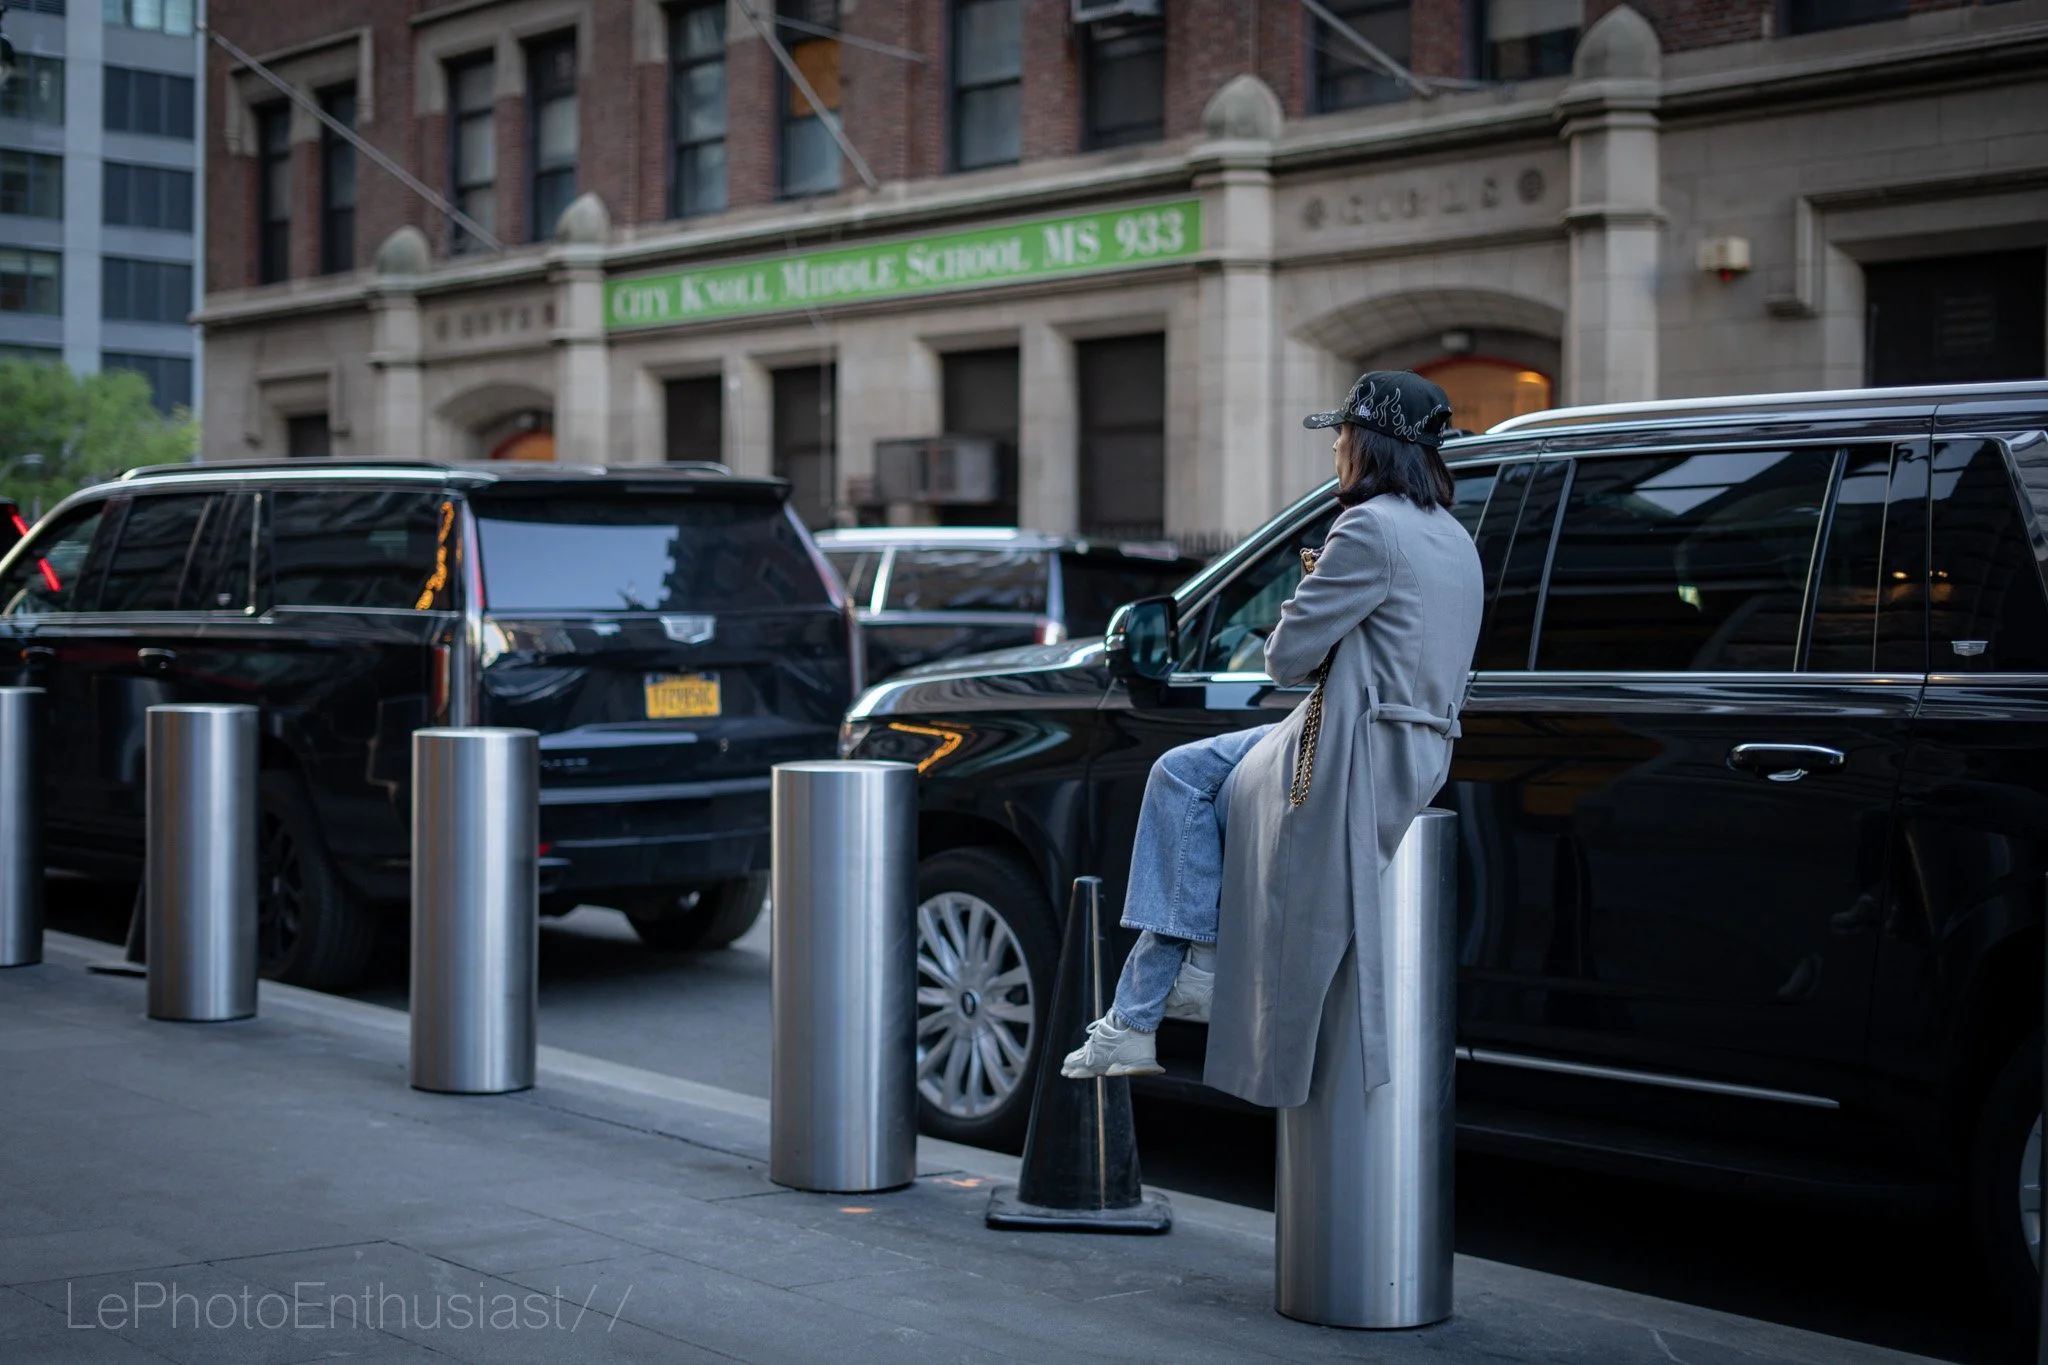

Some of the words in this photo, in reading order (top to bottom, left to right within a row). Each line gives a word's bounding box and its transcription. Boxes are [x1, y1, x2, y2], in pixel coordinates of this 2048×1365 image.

[613, 284, 674, 321] CITY
[781, 254, 899, 299] MIDDLE
[906, 236, 1031, 285] SCHOOL
[1043, 219, 1101, 269] MS
[1115, 207, 1185, 259] 933
